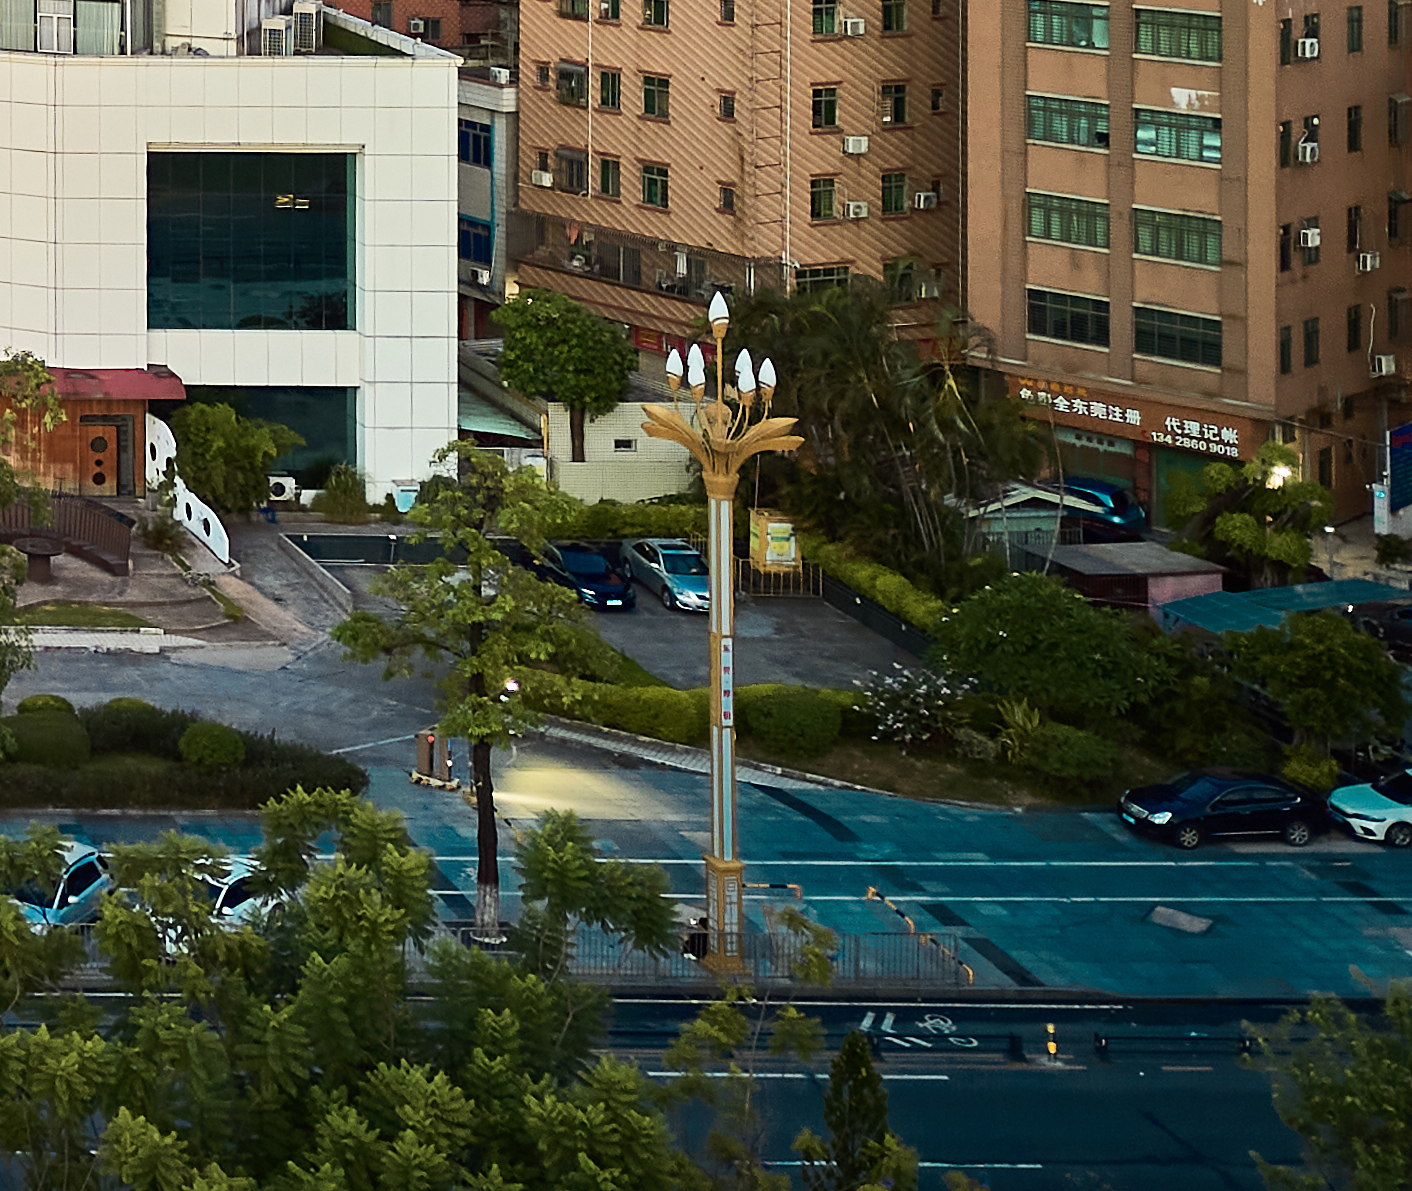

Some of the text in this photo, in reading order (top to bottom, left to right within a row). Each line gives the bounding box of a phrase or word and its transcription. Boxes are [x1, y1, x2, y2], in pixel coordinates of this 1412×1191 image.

[1151, 432, 1239, 457] 134 2860 9018
